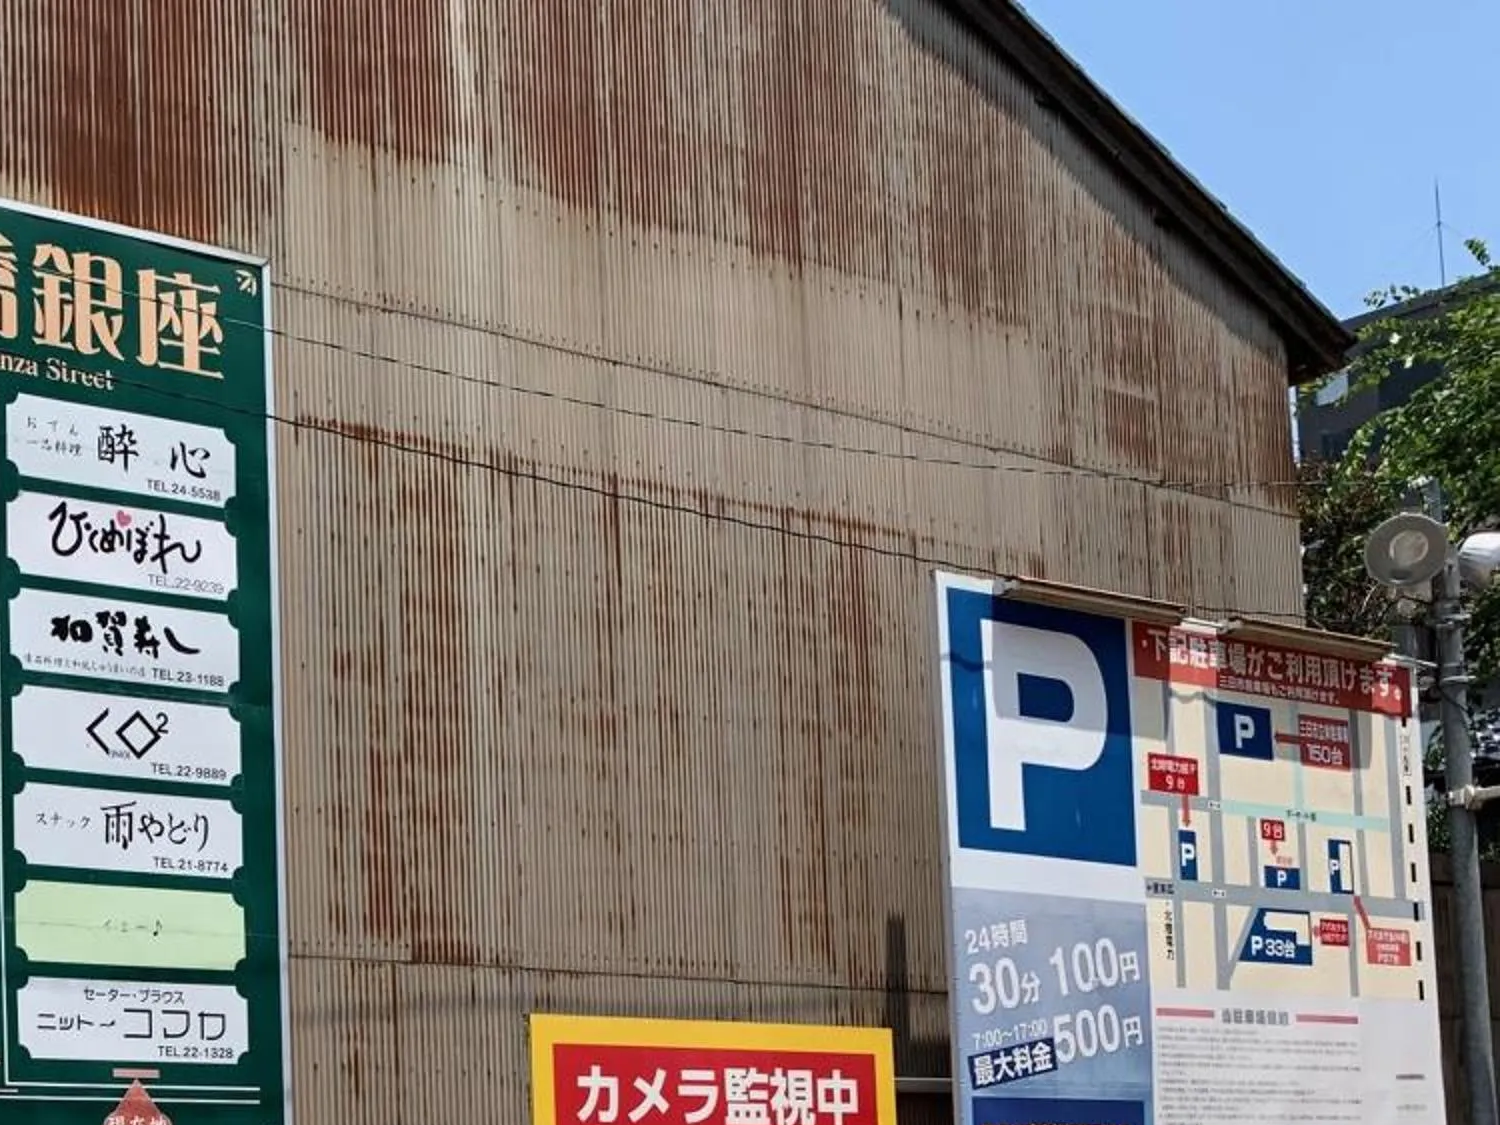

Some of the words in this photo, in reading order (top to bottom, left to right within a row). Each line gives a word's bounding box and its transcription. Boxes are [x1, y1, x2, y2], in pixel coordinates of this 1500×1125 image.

[46, 358, 115, 391] Street
[981, 618, 1108, 831] P
[1234, 714, 1255, 749] P
[100, 800, 209, 852] 雨やどり
[1180, 843, 1196, 867] P
[1277, 870, 1287, 886] P
[964, 919, 1028, 954] 24時間
[1251, 935, 1263, 956] P
[969, 957, 1041, 1015] 30分
[1049, 938, 1140, 997] 100円
[973, 1042, 1053, 1086] 最大料金
[1053, 1004, 1143, 1064] 500円
